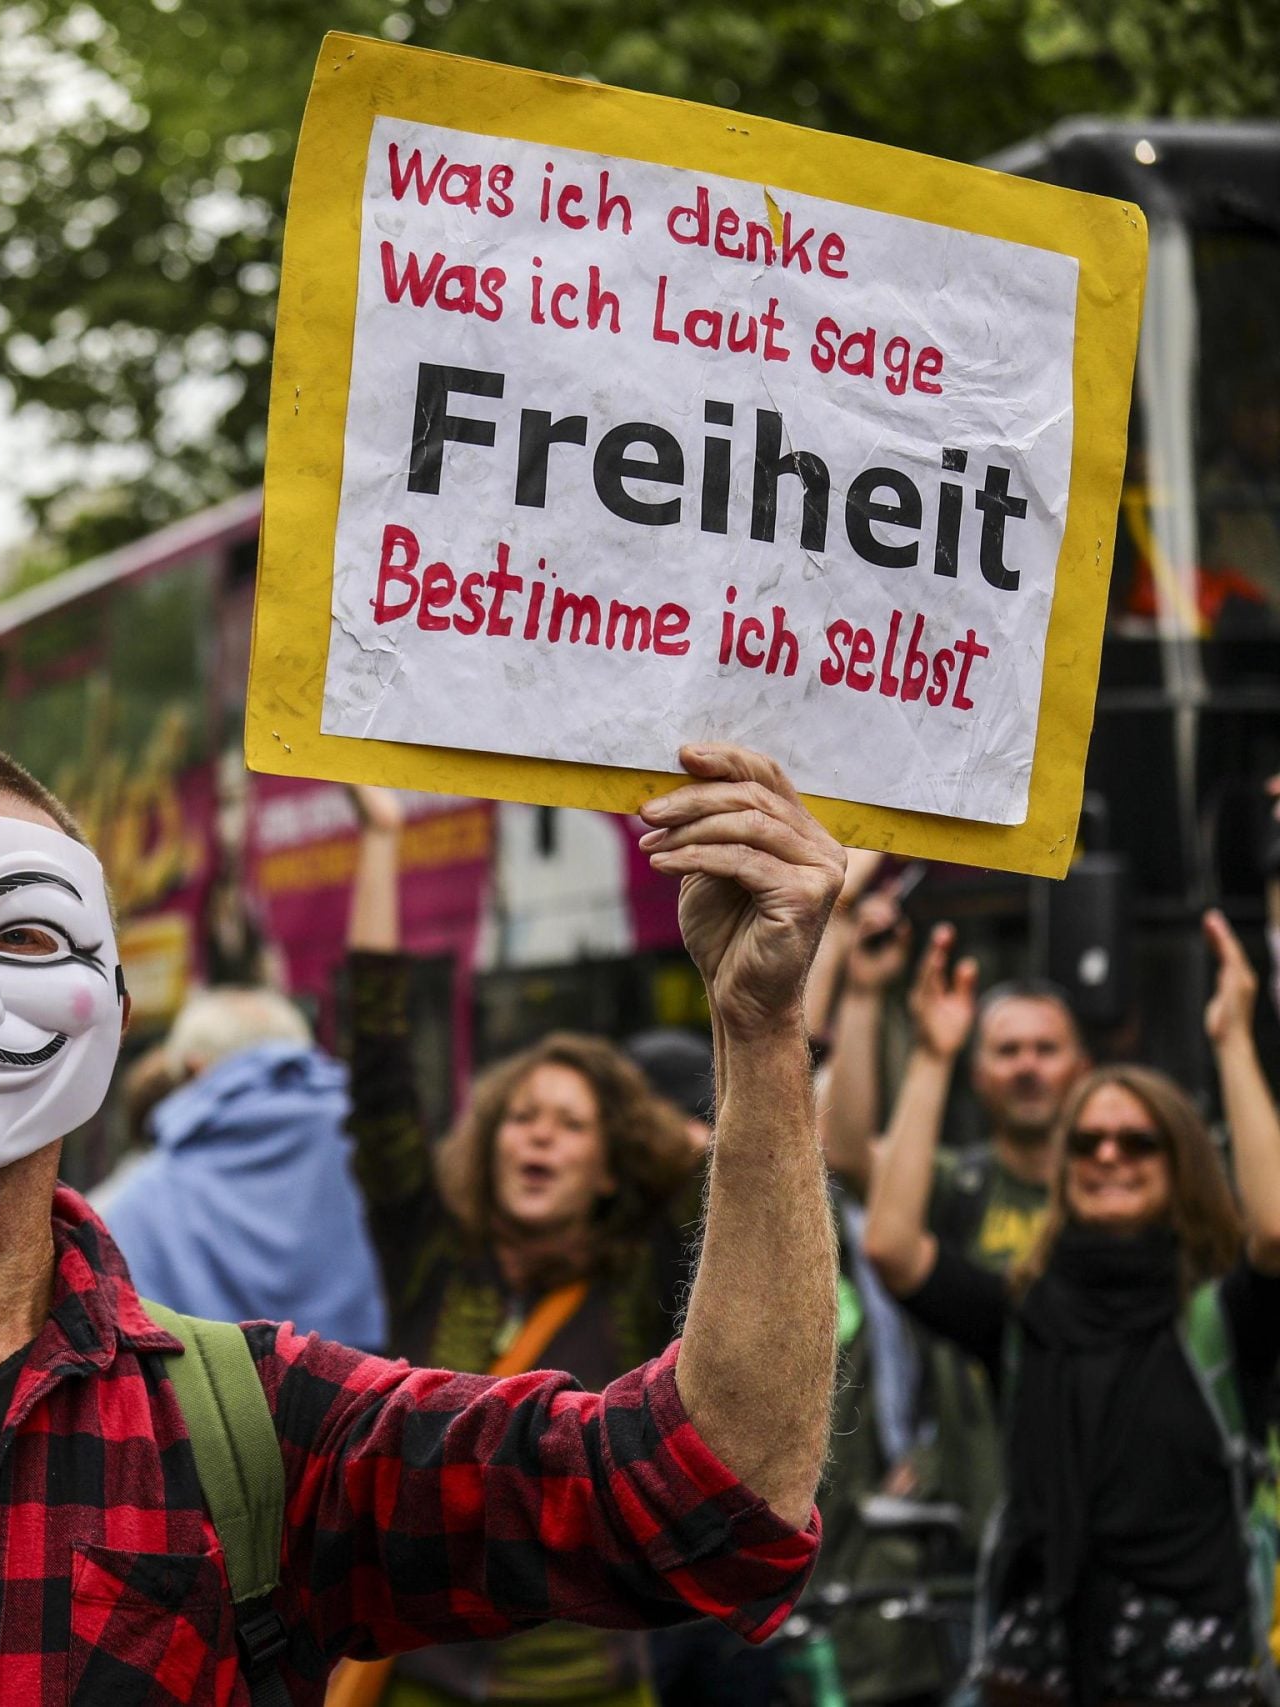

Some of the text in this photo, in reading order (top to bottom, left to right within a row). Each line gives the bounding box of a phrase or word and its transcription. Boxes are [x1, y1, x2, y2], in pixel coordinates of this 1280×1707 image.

[389, 143, 848, 280] Was ich denke
[381, 241, 943, 395] Was ich Laut sage
[408, 363, 1027, 591] Freiheit
[370, 525, 989, 710] Bestimme ich selbst
